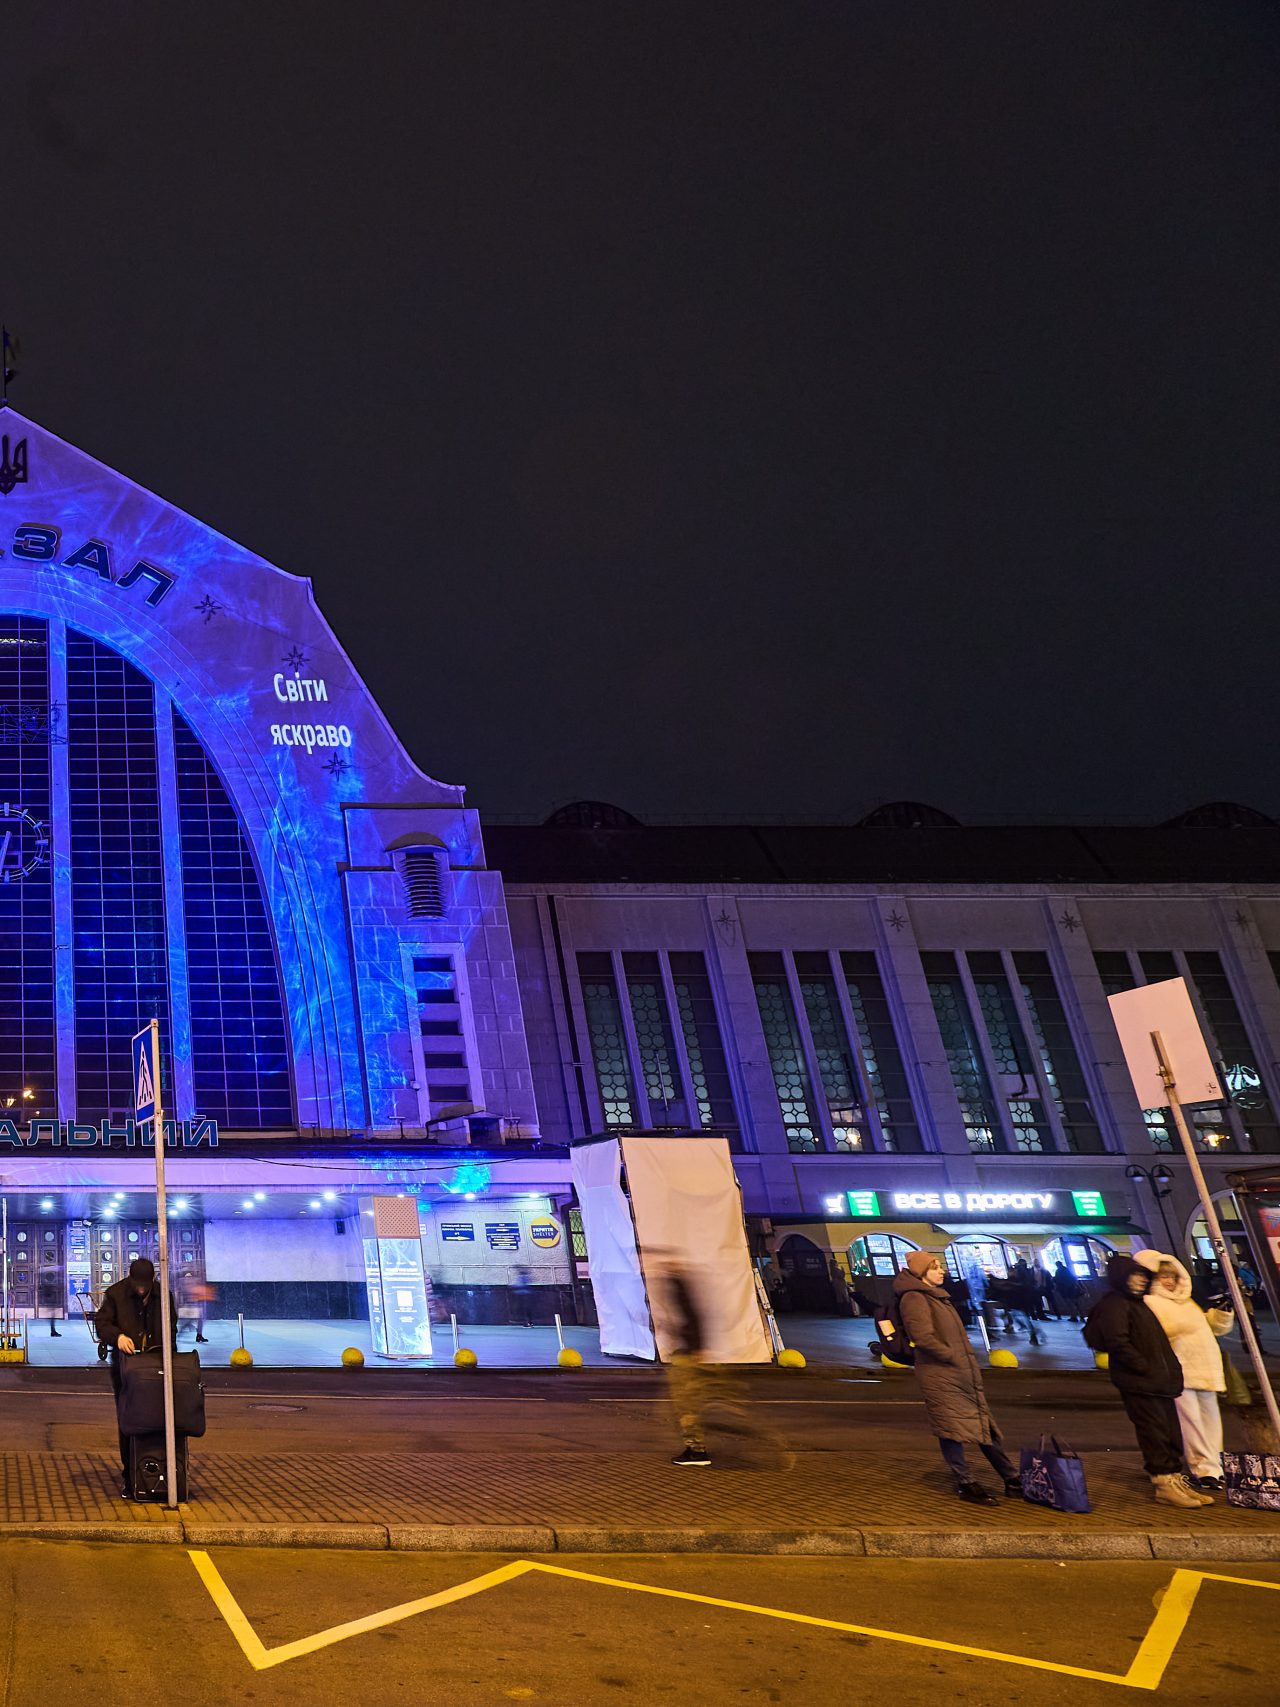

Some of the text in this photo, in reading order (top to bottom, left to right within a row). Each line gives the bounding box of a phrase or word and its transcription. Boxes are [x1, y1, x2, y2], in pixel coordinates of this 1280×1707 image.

[273, 671, 328, 703] Світи
[270, 724, 352, 754] яскраво
[893, 1193, 942, 1209] ВСЕ
[945, 1193, 961, 1209] В
[966, 1193, 1053, 1211] ДОРОГУ
